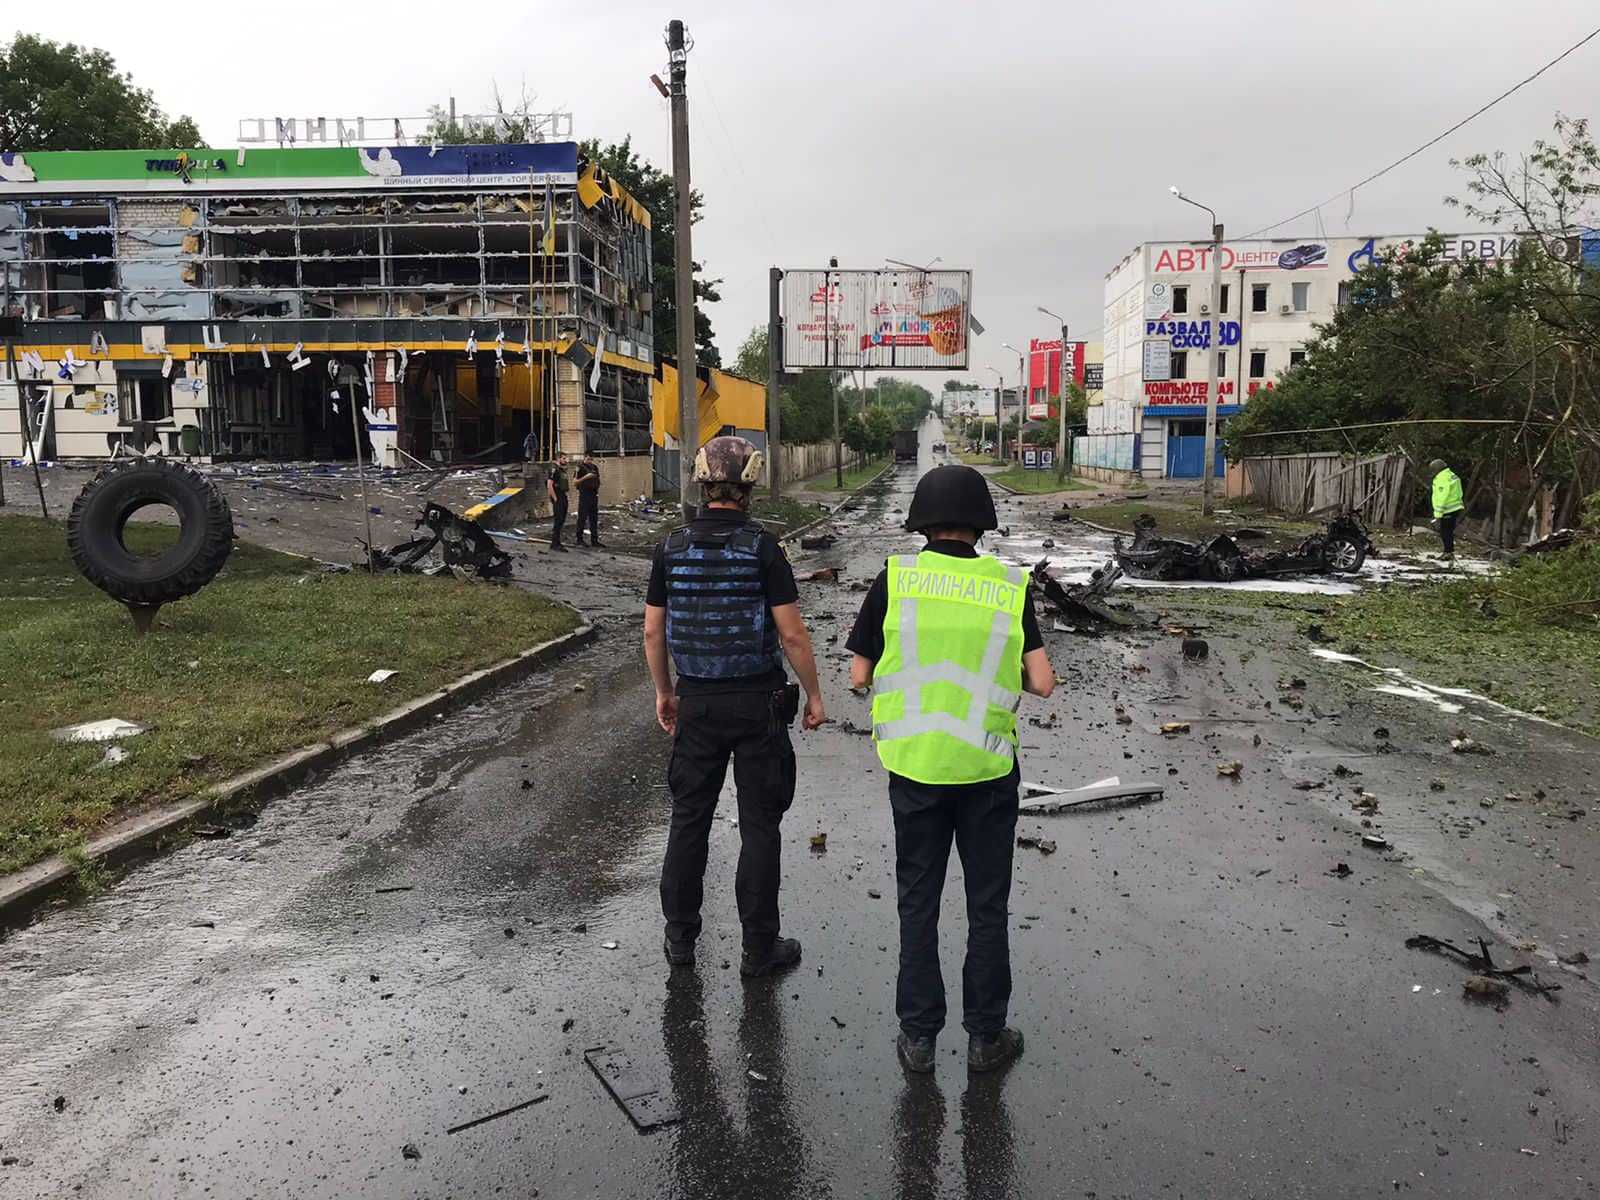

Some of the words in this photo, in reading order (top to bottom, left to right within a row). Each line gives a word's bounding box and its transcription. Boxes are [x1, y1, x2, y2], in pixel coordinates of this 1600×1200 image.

[1146, 320, 1211, 335] РАЗВАЛ
[1218, 320, 1241, 346] 3D
[1171, 334, 1211, 350] СХОД
[1145, 381, 1233, 395] КОМПЬЮТЕРАЯ
[1149, 395, 1225, 406] ДИАГНОСТИА
[896, 570, 1020, 610] КРИМІНАЛІСТ
